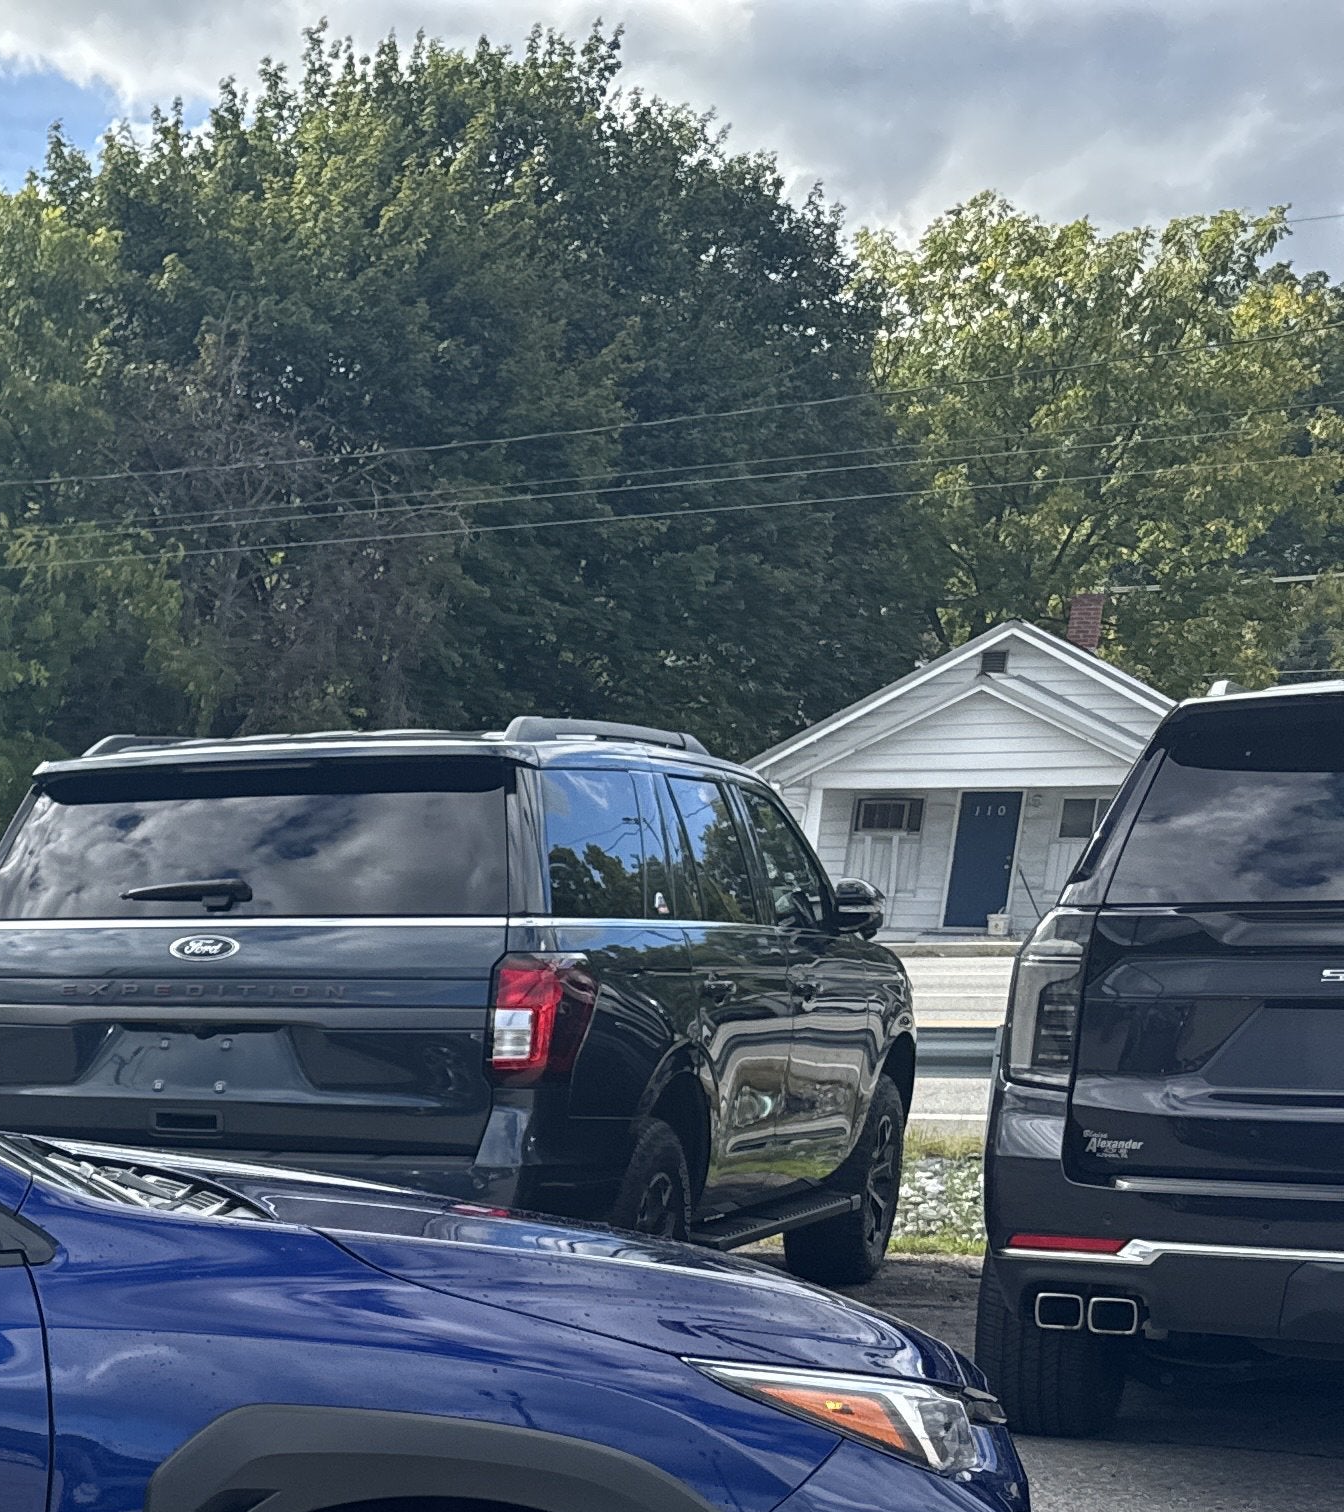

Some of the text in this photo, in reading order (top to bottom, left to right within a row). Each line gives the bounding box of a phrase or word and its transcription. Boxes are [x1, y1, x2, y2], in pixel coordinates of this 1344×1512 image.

[974, 805, 1007, 816] 110
[184, 939, 224, 955] Ford
[62, 983, 347, 998] EXPEDITION
[1085, 1137, 1144, 1152] Alexander
